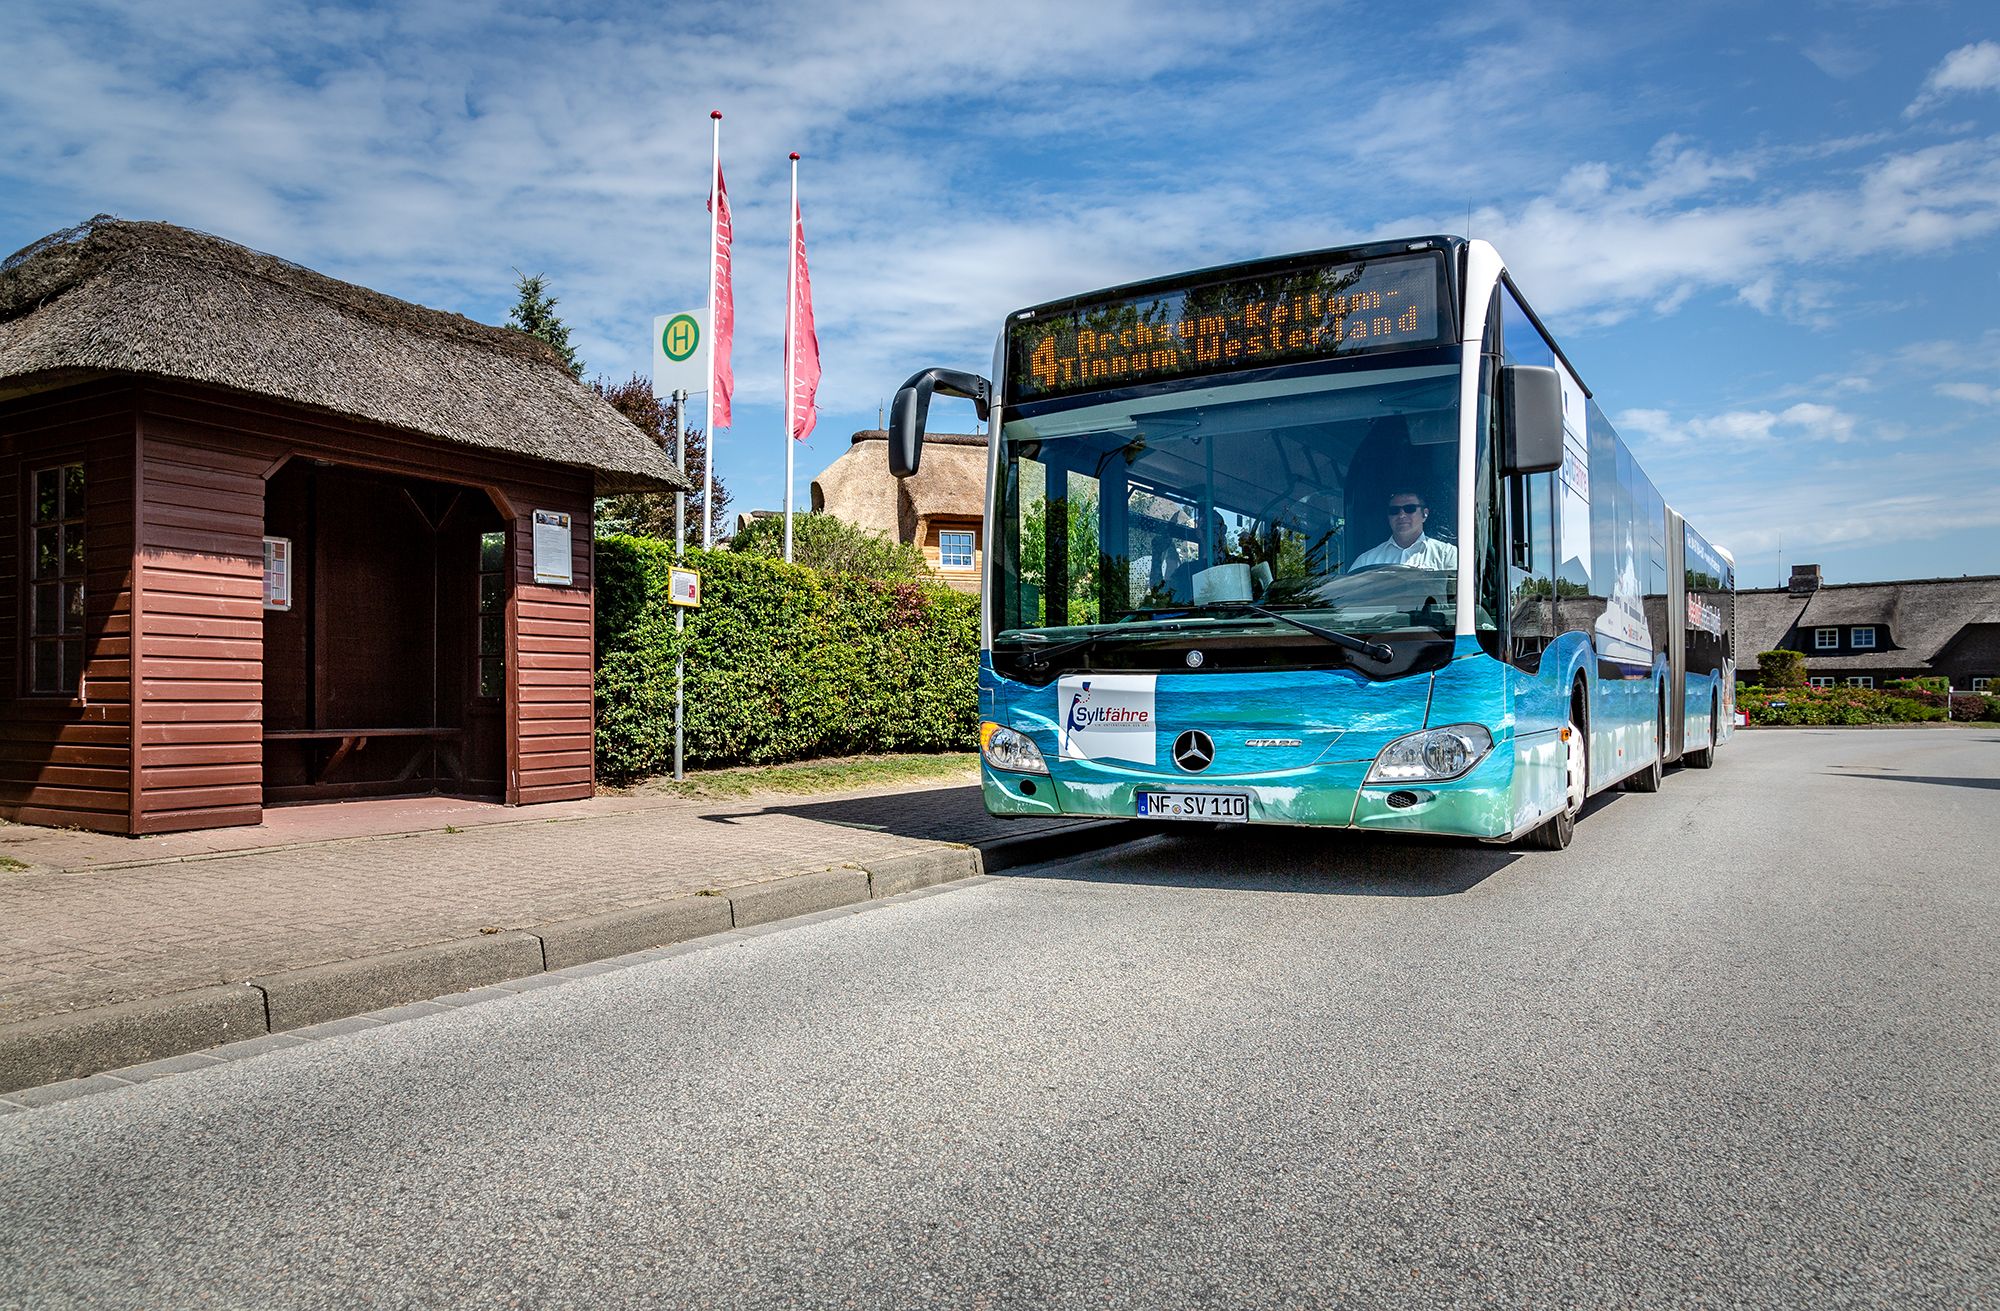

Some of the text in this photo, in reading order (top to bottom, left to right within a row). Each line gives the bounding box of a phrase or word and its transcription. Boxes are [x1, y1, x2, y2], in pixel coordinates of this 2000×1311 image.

[1077, 289, 1399, 354] Archsum-Keitum-
[673, 324, 689, 352] H
[1059, 304, 1417, 381] Tinnum-Westerland
[1031, 335, 1058, 386] 4
[1076, 707, 1149, 726] Syltfähre
[1245, 739, 1302, 747] CITARO
[1148, 795, 1245, 816] NF SV 110
